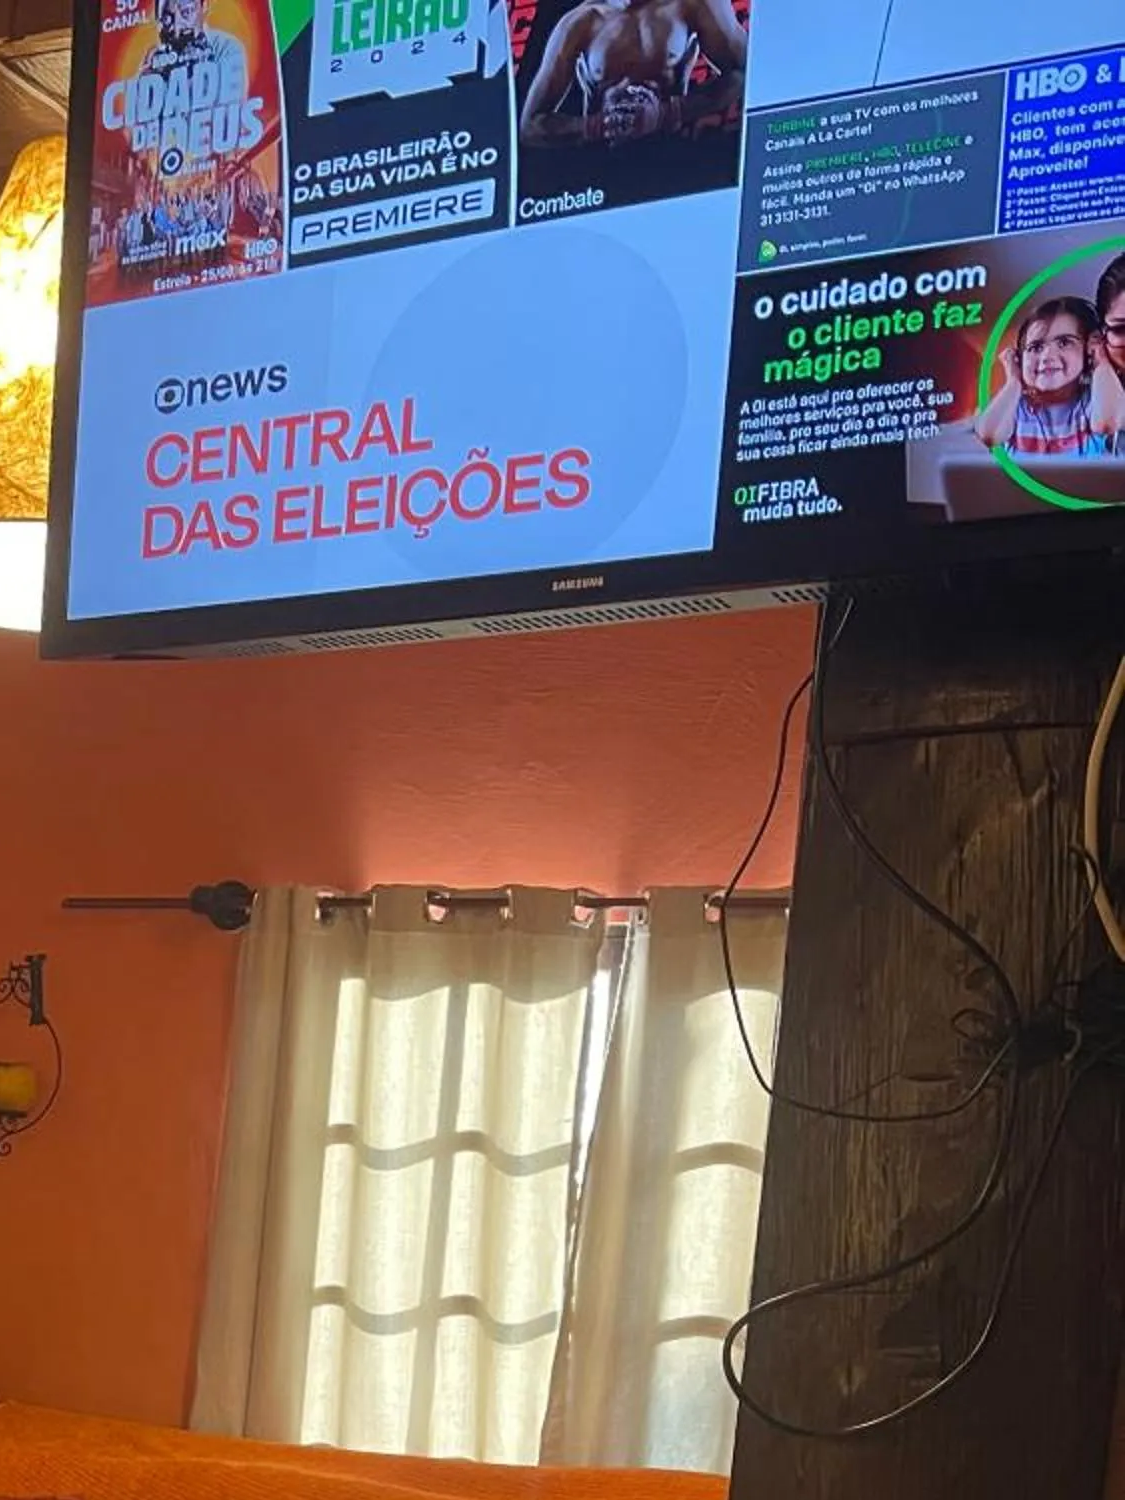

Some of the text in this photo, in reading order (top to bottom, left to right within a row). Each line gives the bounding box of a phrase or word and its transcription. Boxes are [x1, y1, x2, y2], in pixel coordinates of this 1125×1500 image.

[102, 11, 149, 32] CANAL
[102, 59, 248, 130] CIDADE
[1015, 63, 1088, 101] HBO
[1096, 63, 1113, 84] &
[132, 97, 264, 157] DE DEUS
[820, 117, 829, 127] a
[830, 112, 852, 125] sua
[855, 106, 872, 121] TV
[873, 104, 900, 117] com
[902, 101, 917, 113] os
[919, 91, 978, 110] melhores
[1011, 105, 1076, 126] Clientes
[1079, 101, 1114, 115] com
[764, 122, 873, 152] Canais A La Carte!
[1010, 127, 1049, 144] HBO,
[1056, 123, 1086, 137] tem
[294, 131, 472, 182] O BRASILEIRÃO
[762, 163, 803, 179] Assine
[964, 135, 974, 145] e
[1007, 155, 1089, 181] Aproveite!
[1009, 147, 1046, 163] Max,
[293, 147, 499, 204] DA SUA VIDA É NO
[762, 179, 804, 194] muitos
[805, 171, 844, 187] outros
[846, 169, 862, 180] de
[864, 163, 901, 177] forma
[903, 155, 942, 172] rápida
[792, 189, 834, 206] Manda
[835, 187, 856, 199] um
[884, 179, 901, 191] no
[902, 169, 967, 188] WhatsApp
[301, 188, 484, 245] PREMIERE
[519, 186, 604, 219] Combate
[176, 229, 228, 255] max
[755, 264, 987, 319] o cuidado com
[788, 301, 982, 350] o cliente faz
[764, 346, 881, 383] mágica
[186, 363, 288, 407] news
[740, 400, 751, 416] A
[768, 393, 797, 412] está
[800, 390, 830, 407] aqui
[832, 389, 855, 405] pra
[856, 381, 915, 400] oferecer
[916, 378, 935, 392] os
[739, 411, 802, 432] melhores
[803, 403, 860, 422] serviços
[862, 400, 886, 417] pra
[927, 391, 955, 406] sua
[814, 422, 840, 437] seu
[842, 417, 863, 433] dia
[877, 413, 899, 429] dia
[901, 412, 911, 426] e
[913, 408, 938, 425] pra
[144, 398, 434, 490] CENTRAL
[736, 448, 761, 463] sua
[762, 443, 796, 459] casa
[798, 439, 828, 453] ficar
[830, 433, 869, 450] ainda
[870, 427, 905, 446] mais
[141, 446, 592, 560] DAS ELEIÇÕES
[743, 495, 844, 523] muda tudo.
[552, 575, 605, 592] SAMSUNG
